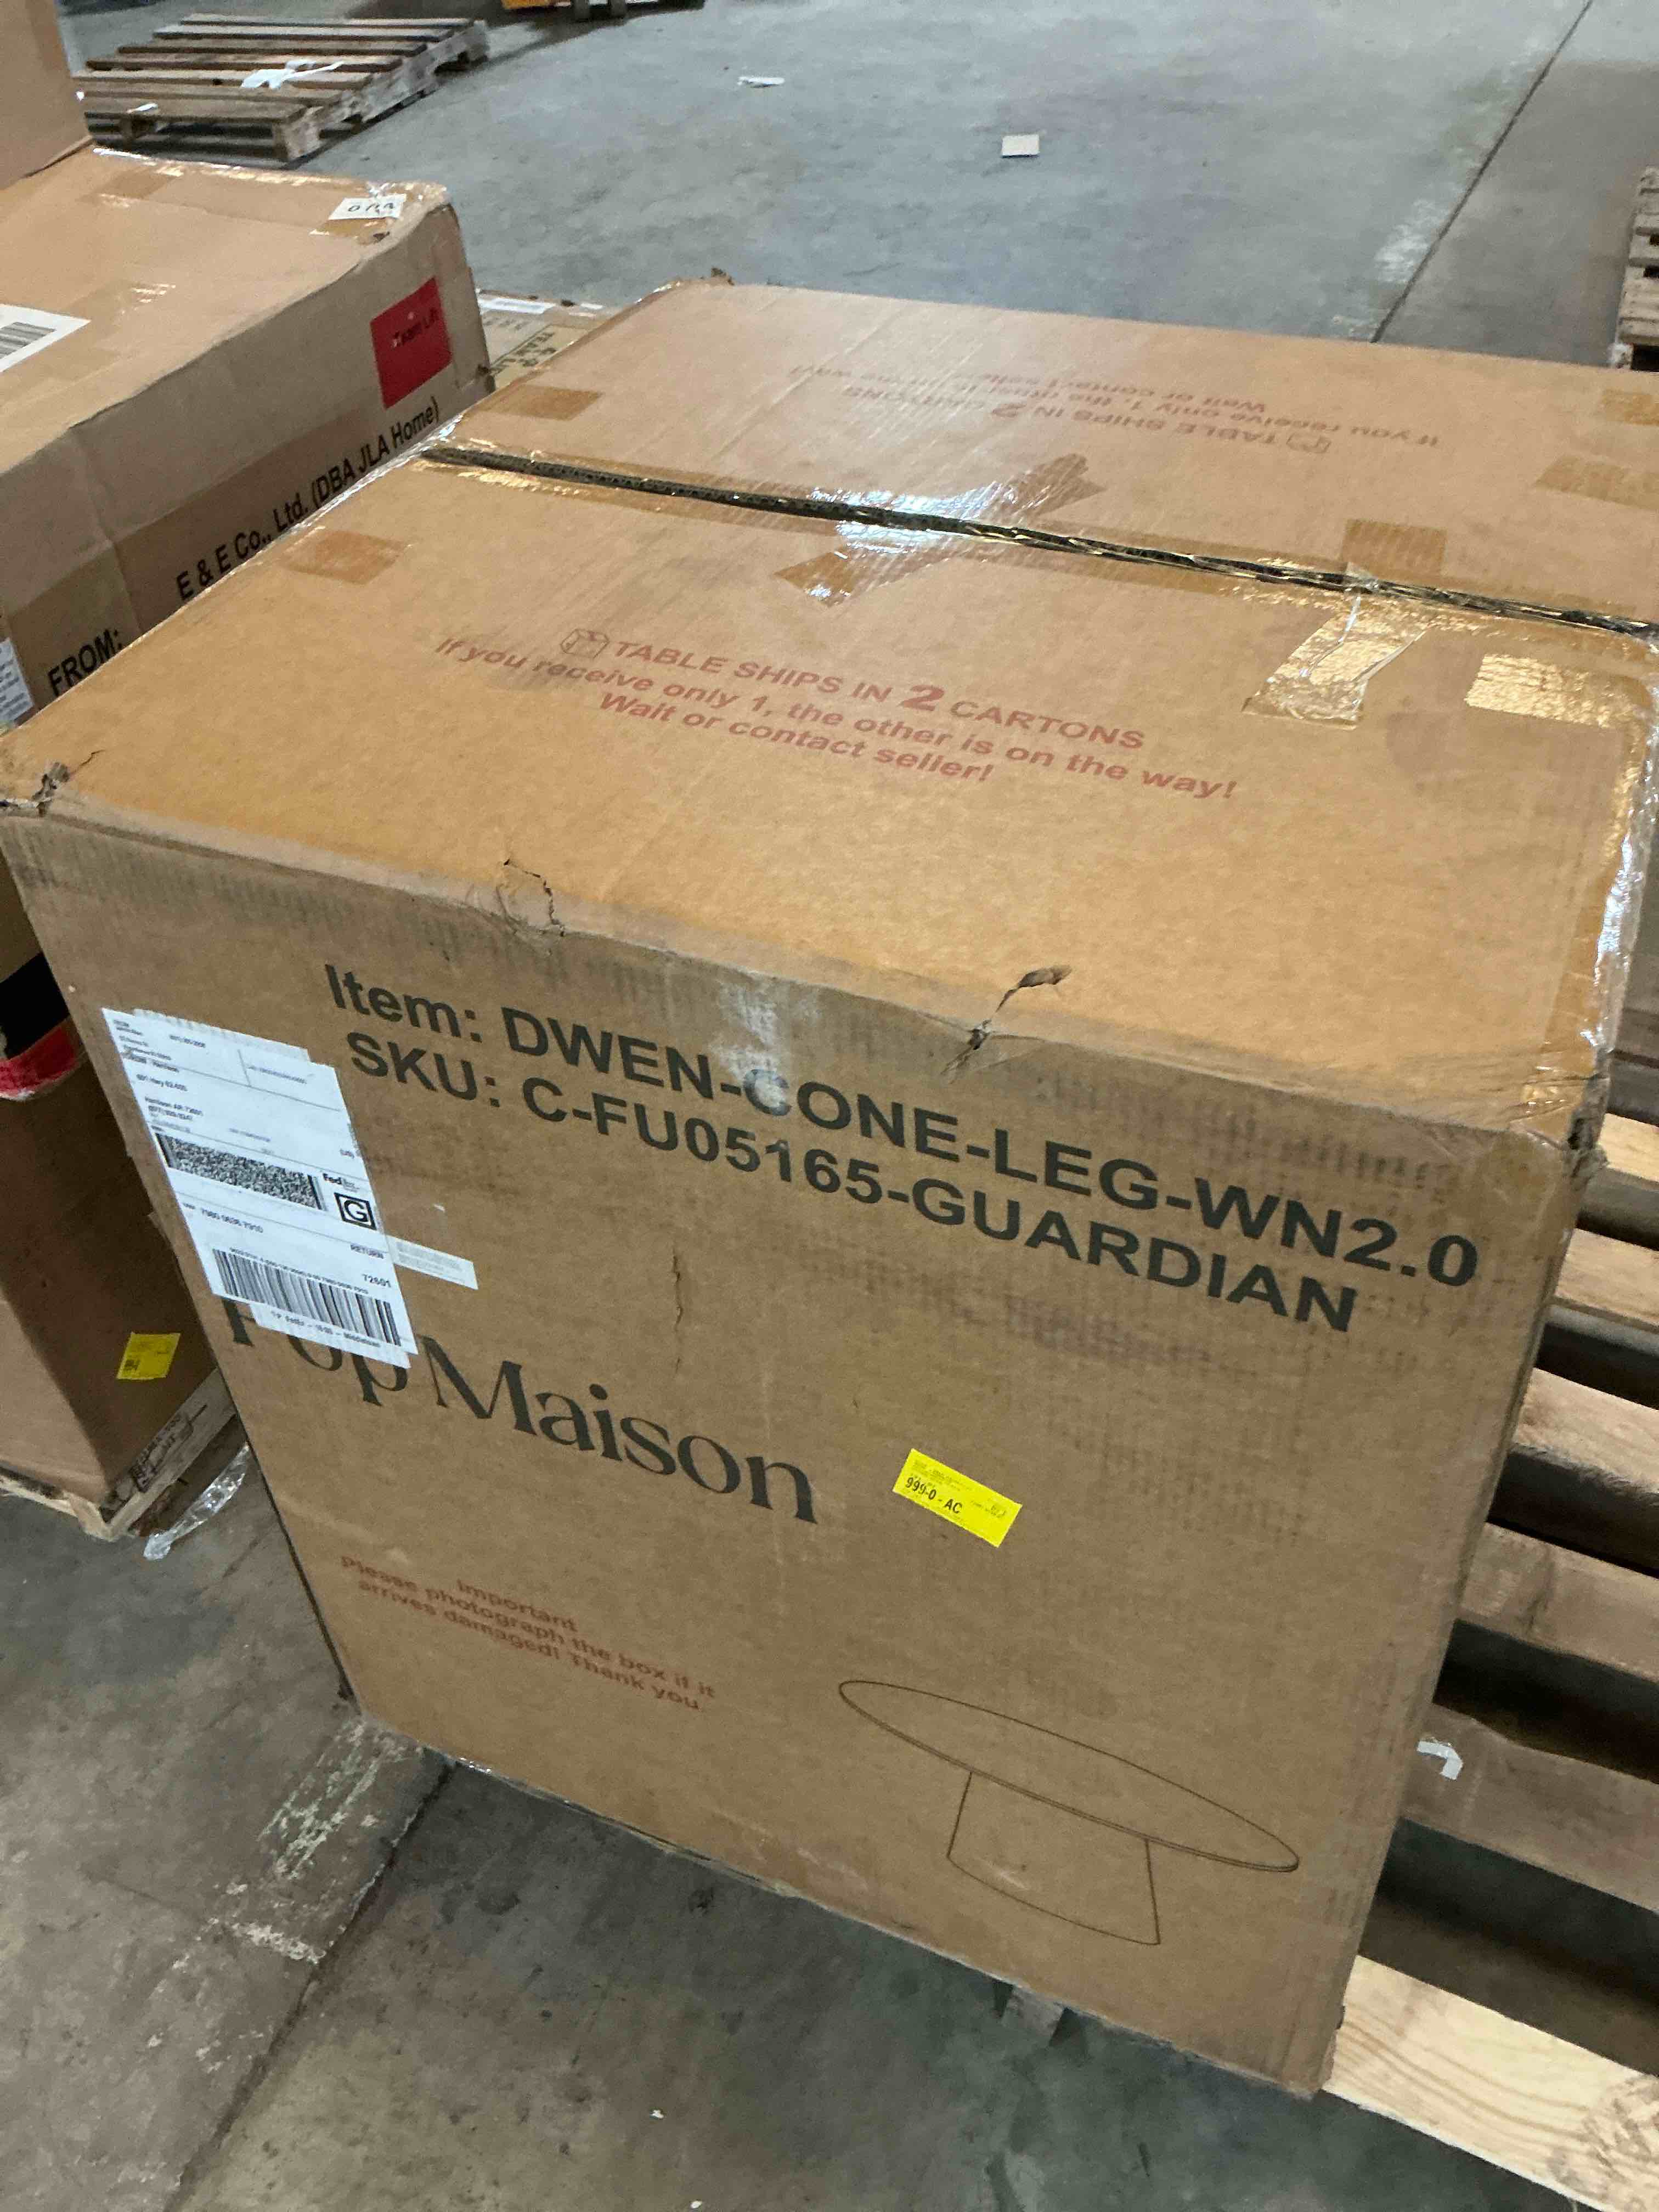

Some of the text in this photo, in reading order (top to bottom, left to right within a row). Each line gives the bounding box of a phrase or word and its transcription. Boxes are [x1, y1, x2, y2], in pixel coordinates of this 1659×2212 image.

[176, 571, 195, 601] E
[198, 560, 213, 586] &
[215, 544, 232, 574] E
[273, 493, 308, 533] Ltd.
[311, 458, 356, 509] (DBA
[358, 434, 390, 473] JLA
[391, 396, 439, 449] Home)
[47, 629, 123, 697] FROM:
[435, 637, 1238, 799] If you receive only 1, the other is on the way!
[615, 640, 1146, 749] TABLE SHIPS IN 2 CARTONS
[600, 692, 994, 783] Wait or contact seller!
[324, 963, 1478, 1288] Item: DWEN-CONE-LEG-WN2.0
[345, 1031, 1358, 1333] SKU: C-FU05165-GUARDIAN
[343, 1199, 371, 1223] G
[944, 1498, 963, 1514] AC
[341, 1555, 419, 1592] Please
[425, 1588, 565, 1645] photograph
[572, 1638, 611, 1660] the
[619, 1652, 666, 1681] box
[358, 1580, 437, 1616] arrives
[651, 1684, 700, 1711] you
